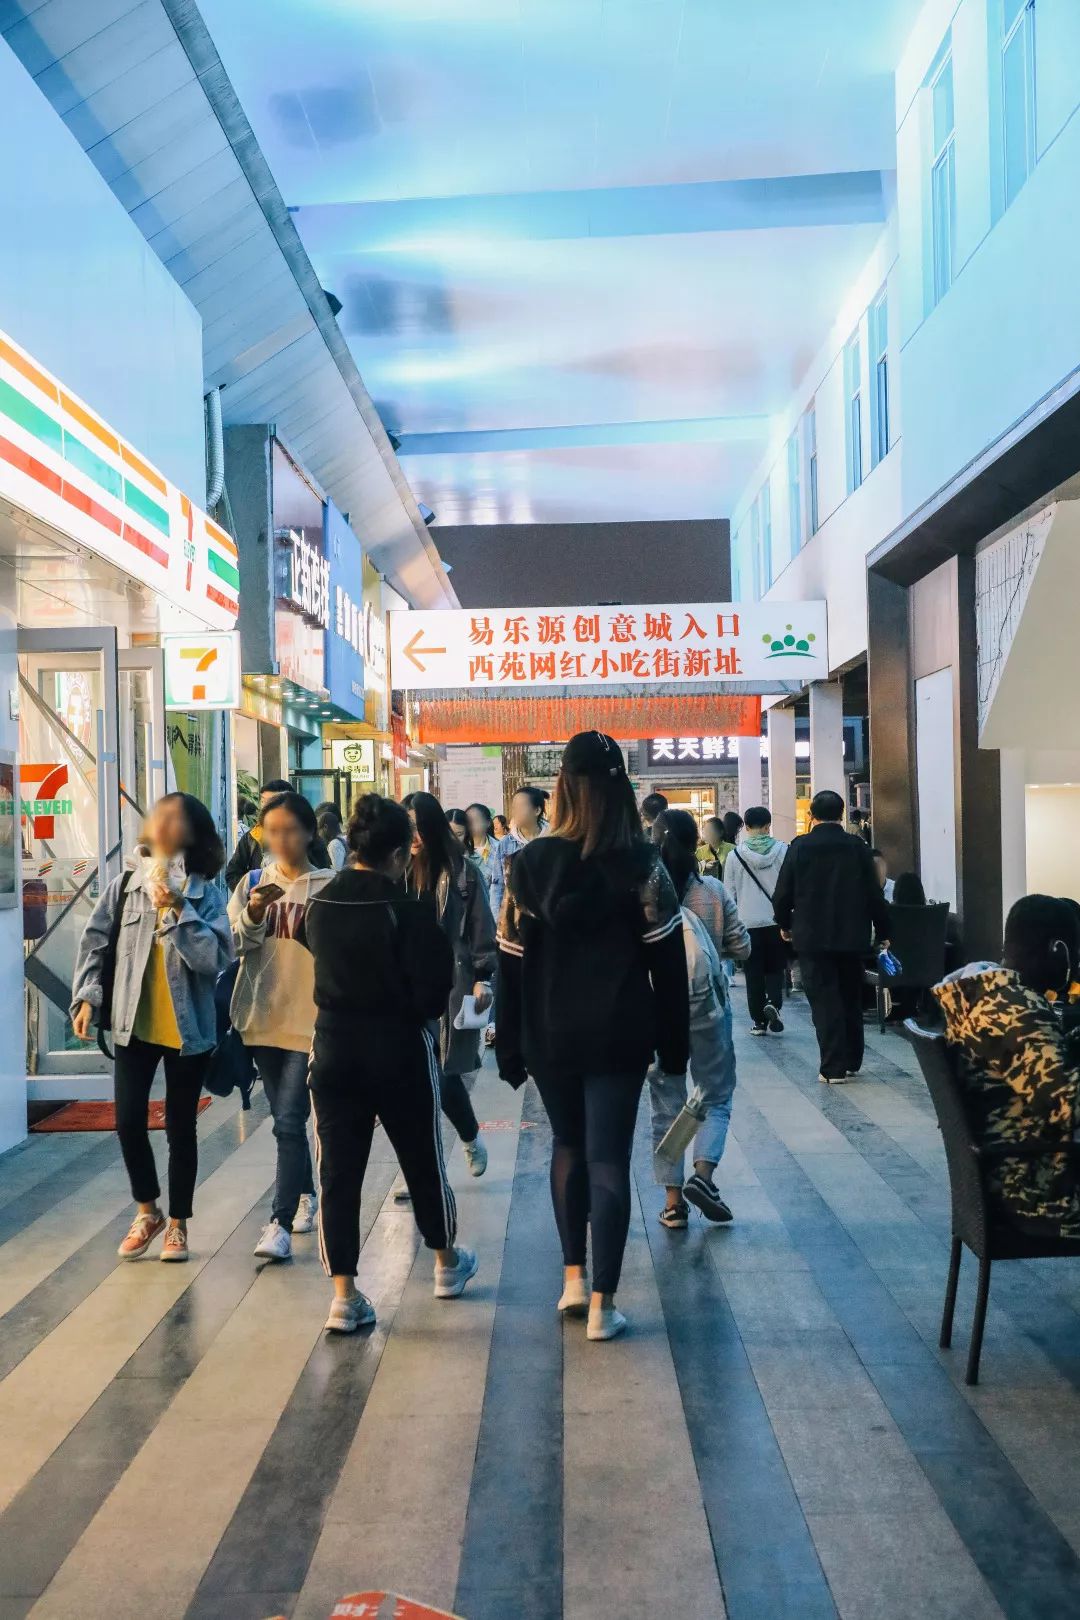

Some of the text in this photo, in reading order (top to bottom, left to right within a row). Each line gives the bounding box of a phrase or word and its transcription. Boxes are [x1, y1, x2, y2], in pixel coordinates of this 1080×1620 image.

[468, 613, 740, 646] 易乐源创意城入口
[180, 648, 218, 700] 7
[468, 647, 744, 682] 西苑网红小吃街新址
